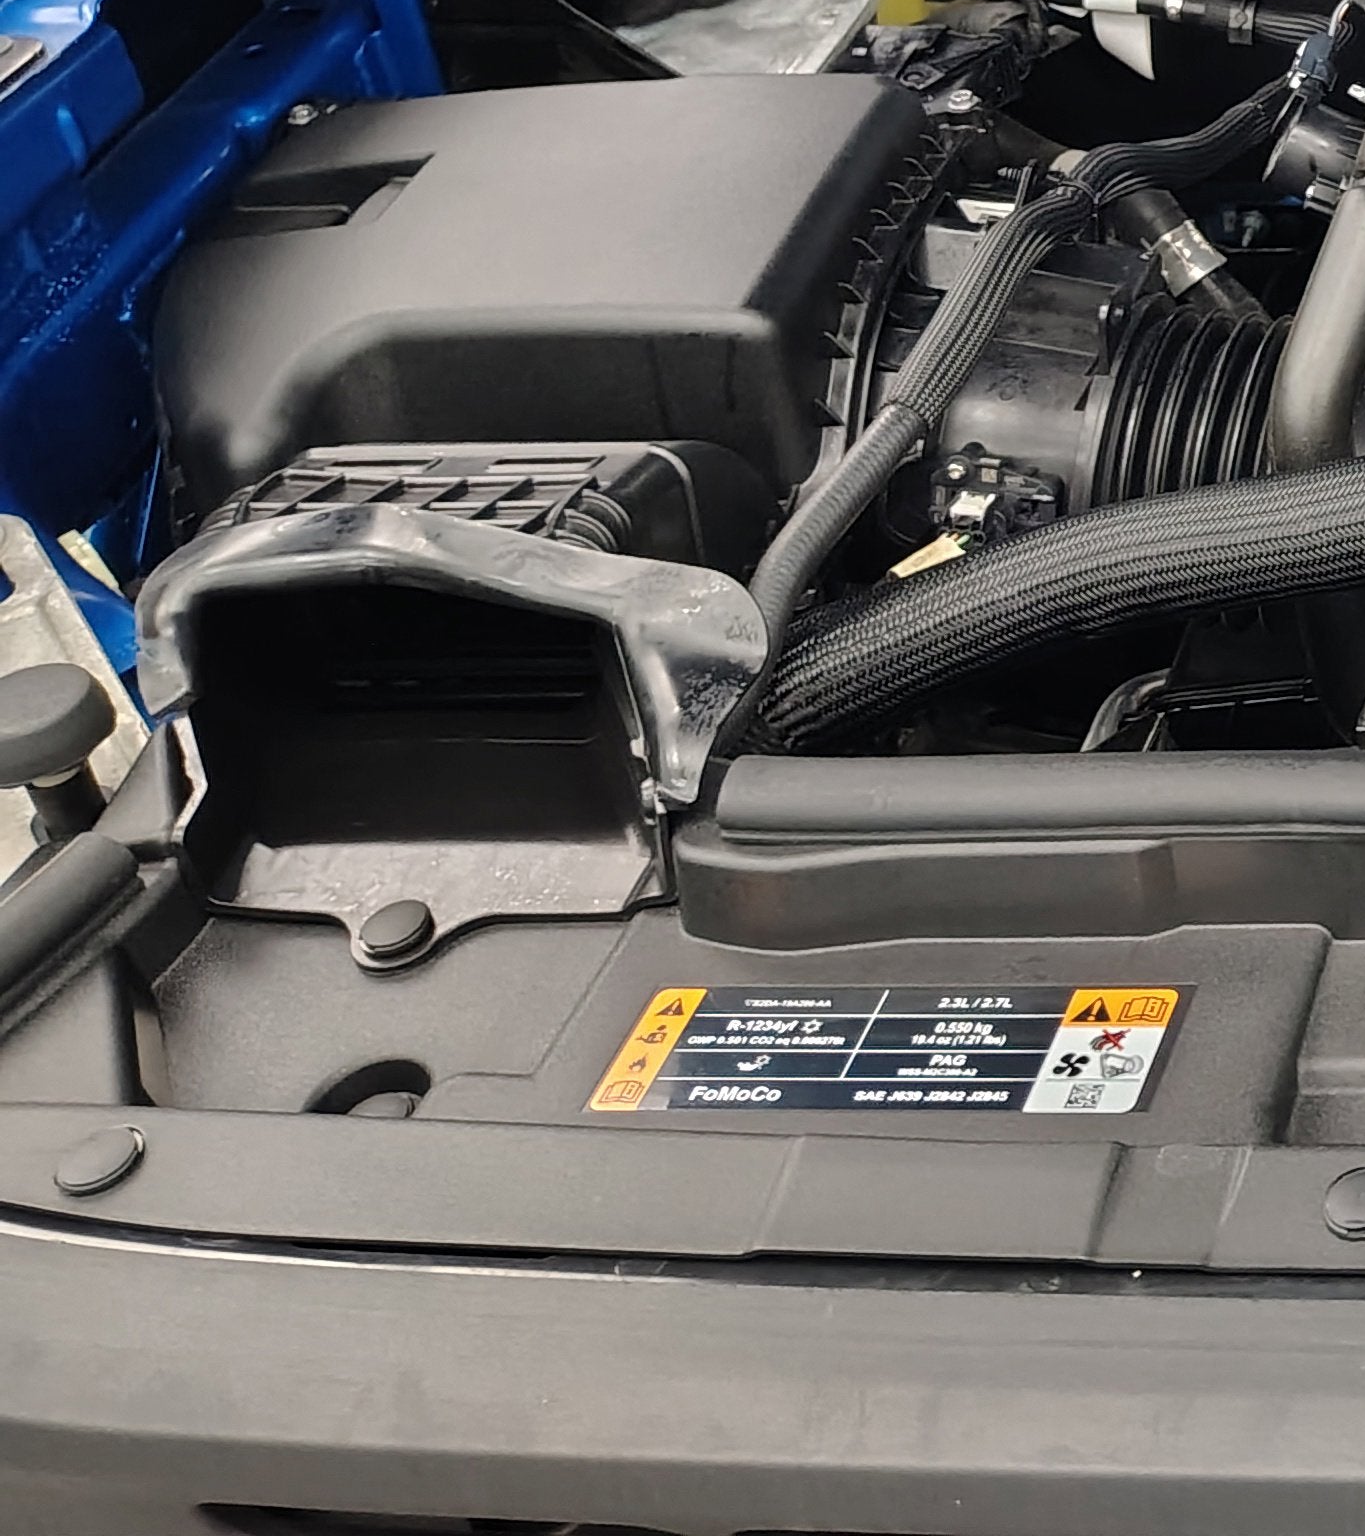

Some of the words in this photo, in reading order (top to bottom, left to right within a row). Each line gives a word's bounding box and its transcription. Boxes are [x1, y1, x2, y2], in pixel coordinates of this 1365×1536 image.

[937, 997, 970, 1009] 2.3L
[980, 997, 1013, 1009] 2.7L
[726, 1019, 798, 1034] R-1234yf
[934, 1021, 974, 1034] 0.550
[974, 1021, 993, 1036] kg
[929, 1054, 967, 1066] PAG
[688, 1085, 782, 1101] FoMoCo
[854, 1090, 887, 1102] SAE
